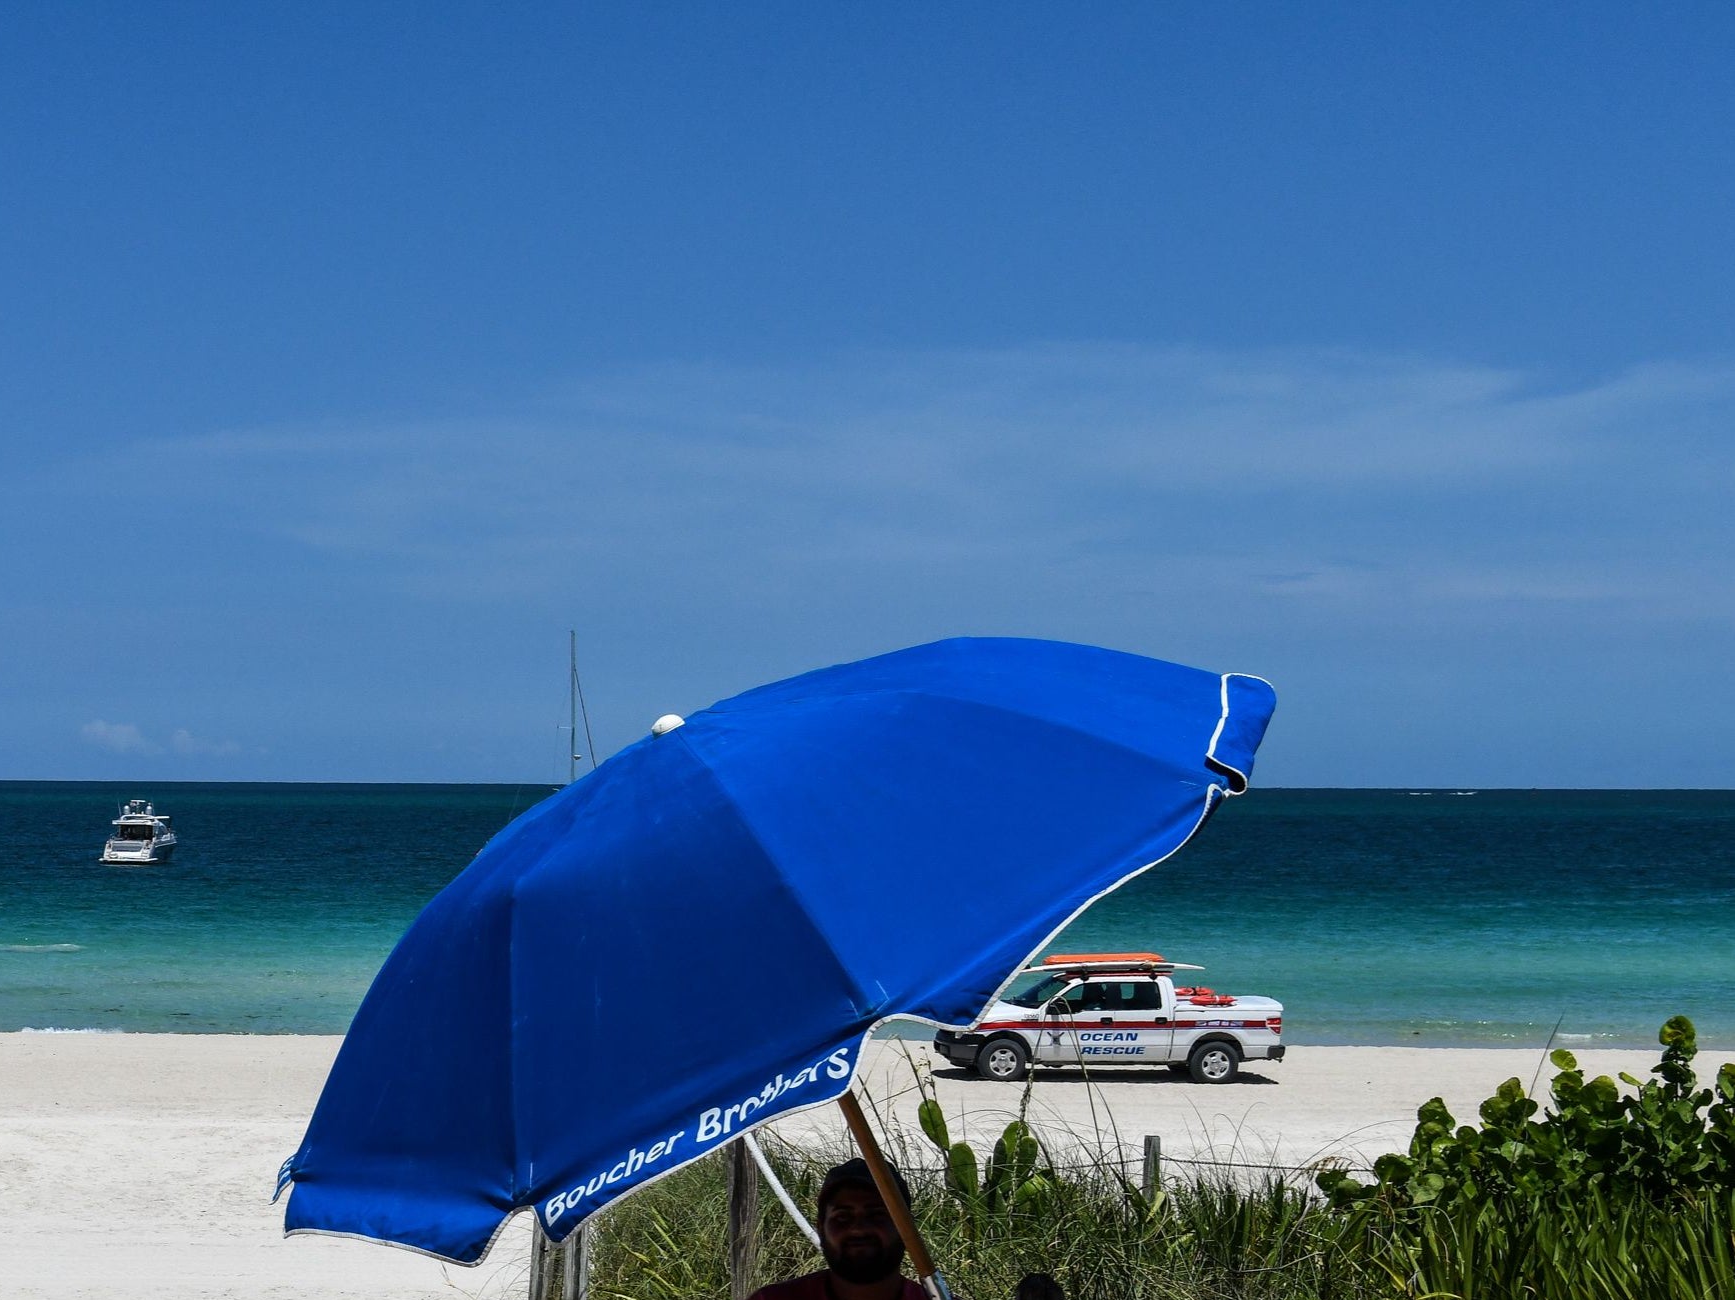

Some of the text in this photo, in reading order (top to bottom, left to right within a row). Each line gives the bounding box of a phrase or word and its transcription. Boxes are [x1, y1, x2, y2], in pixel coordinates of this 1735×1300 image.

[1080, 1032, 1139, 1042] OCEAN
[1080, 1046, 1146, 1055] RESCUE
[544, 1047, 851, 1228] Boucher Brothers
